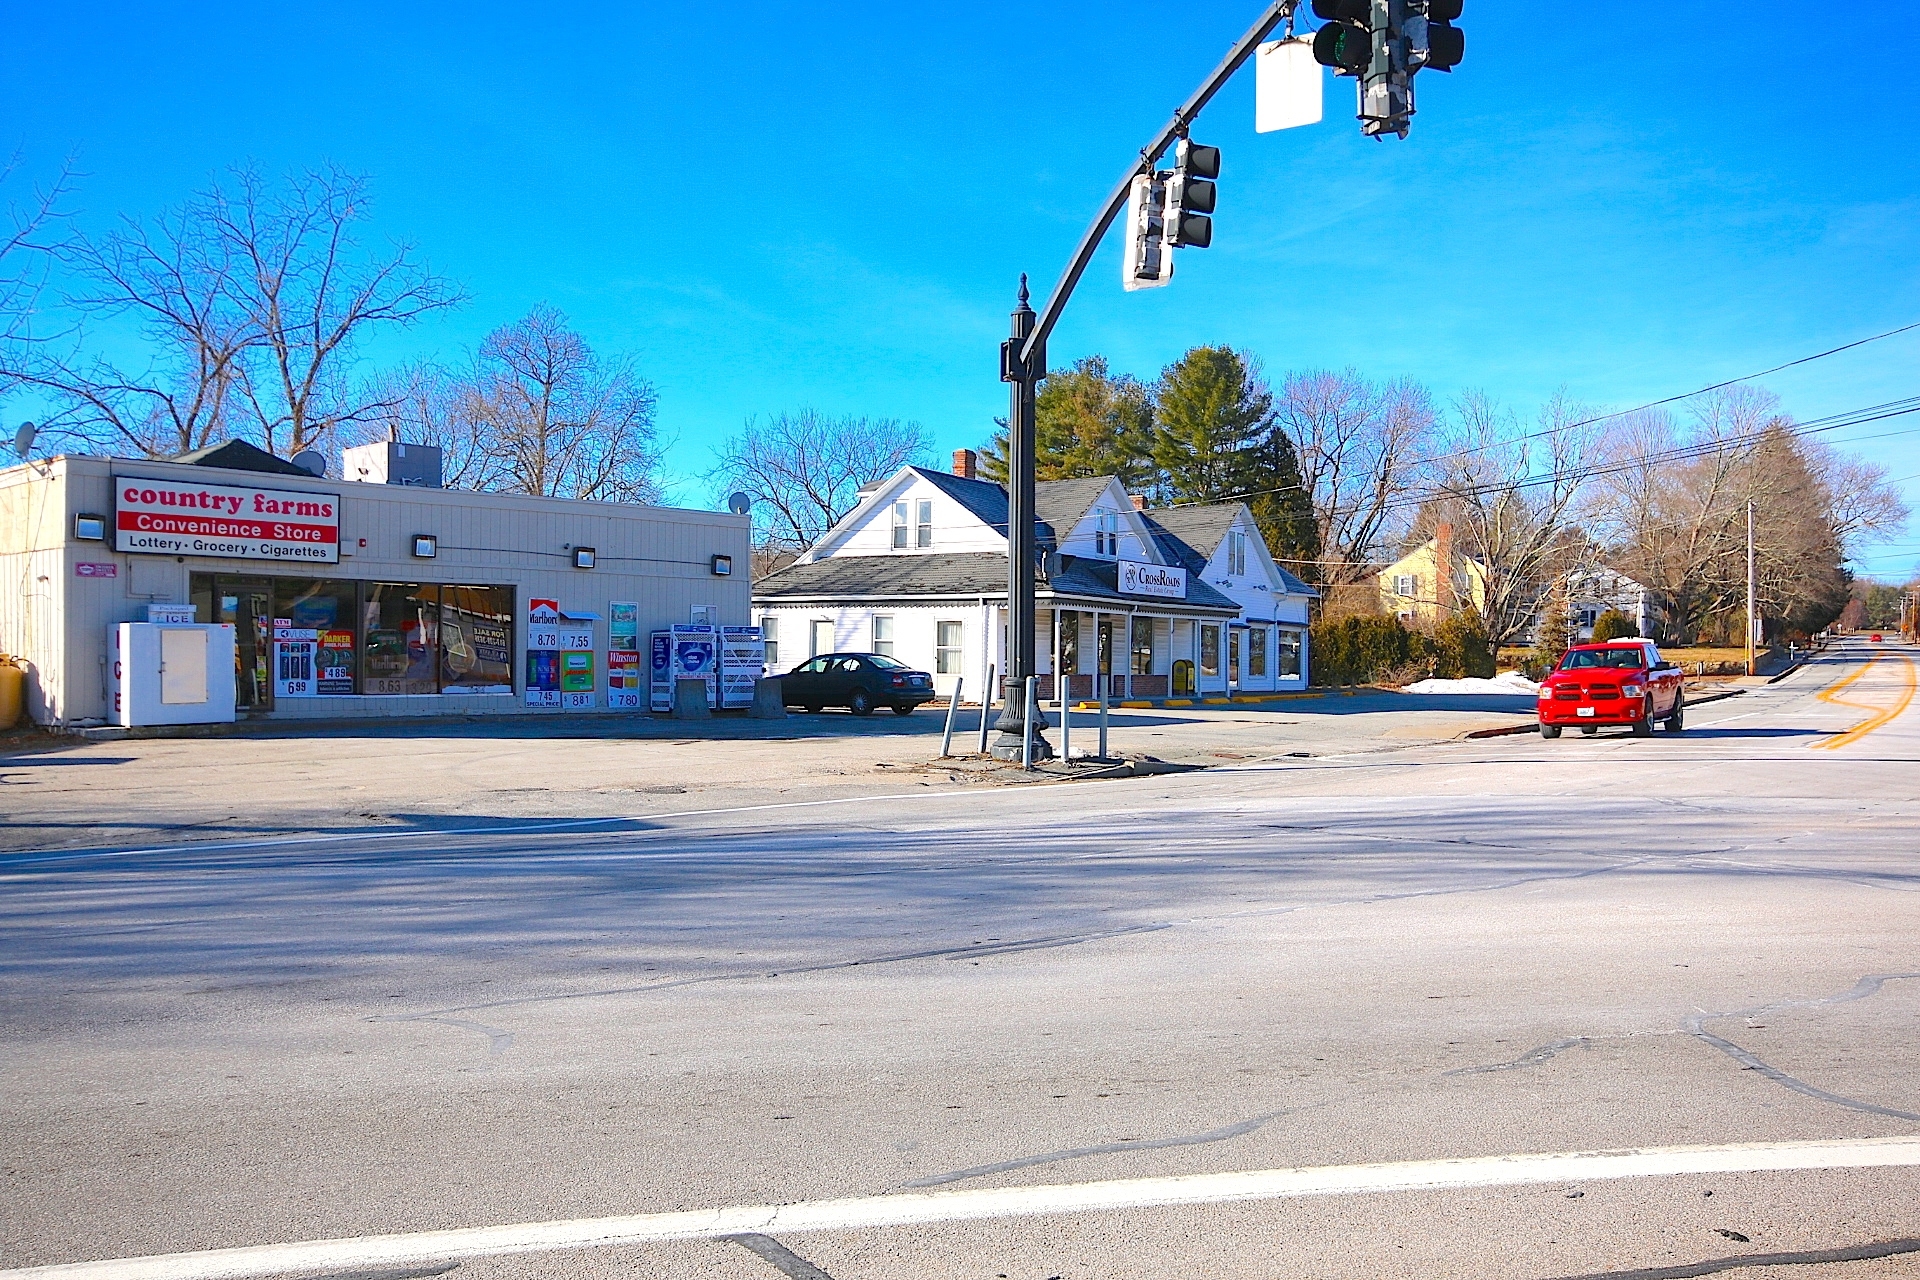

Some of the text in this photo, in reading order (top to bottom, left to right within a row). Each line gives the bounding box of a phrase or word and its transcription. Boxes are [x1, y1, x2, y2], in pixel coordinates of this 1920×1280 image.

[123, 487, 333, 518] country farms
[136, 514, 322, 541] Convenience Store
[129, 535, 327, 558] Lottery Grocery Cigarettes
[166, 615, 189, 623] ICE
[324, 635, 351, 643] DARKER
[537, 634, 556, 646] 8.78
[570, 636, 589, 648] 7.55
[609, 652, 638, 663] Winston
